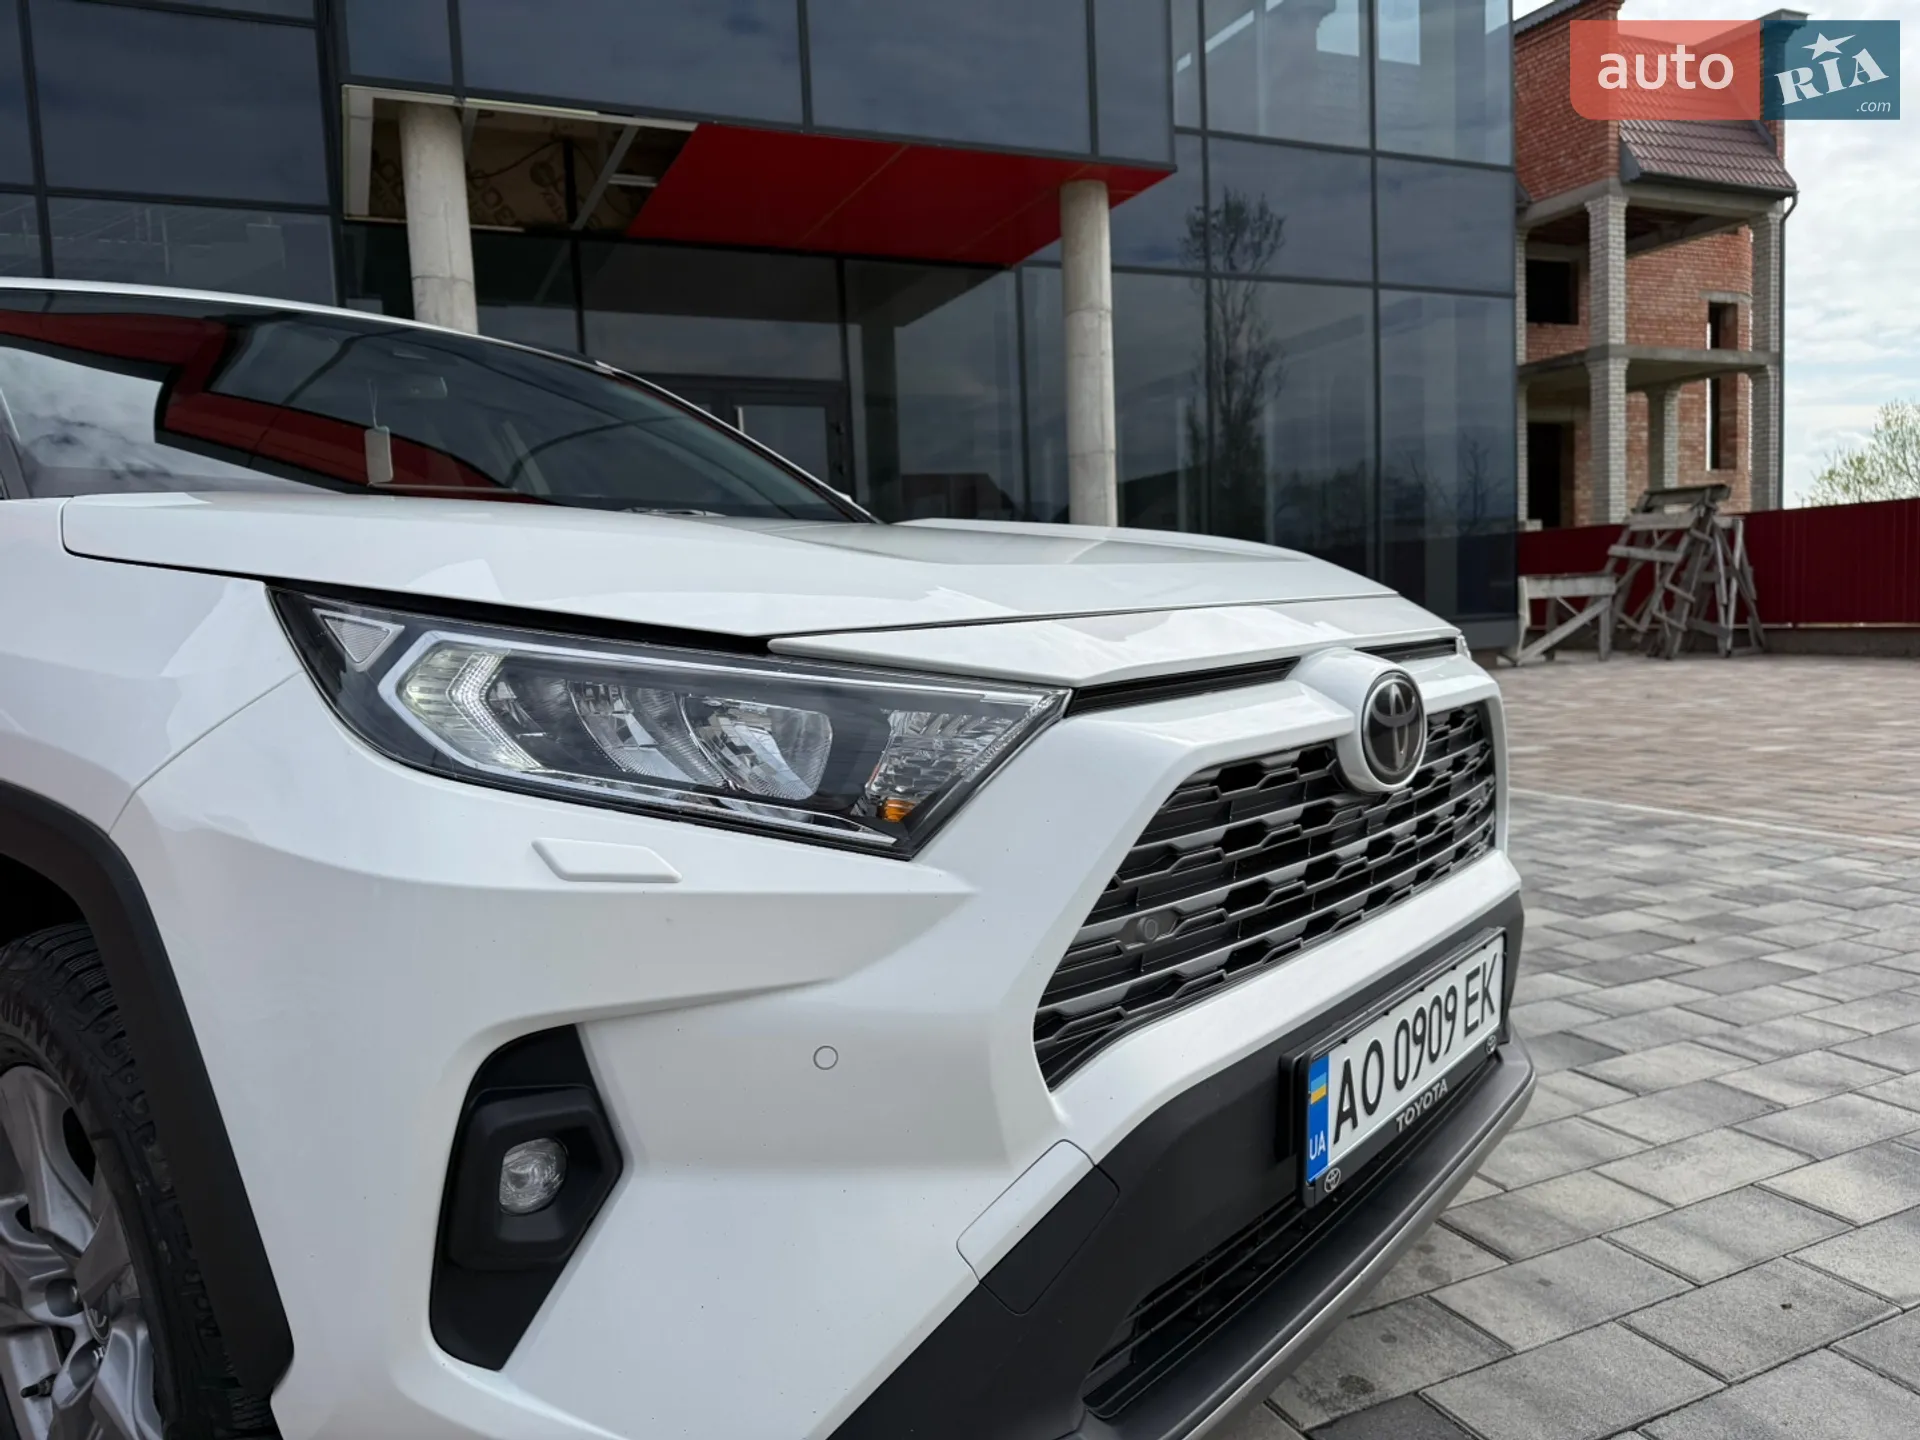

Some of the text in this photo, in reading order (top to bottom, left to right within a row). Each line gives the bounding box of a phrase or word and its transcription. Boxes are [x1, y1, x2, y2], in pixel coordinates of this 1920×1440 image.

[1333, 952, 1498, 1145] AO 0909 EK
[1396, 1078, 1448, 1133] TOYOTA
[1309, 1130, 1327, 1160] UA
